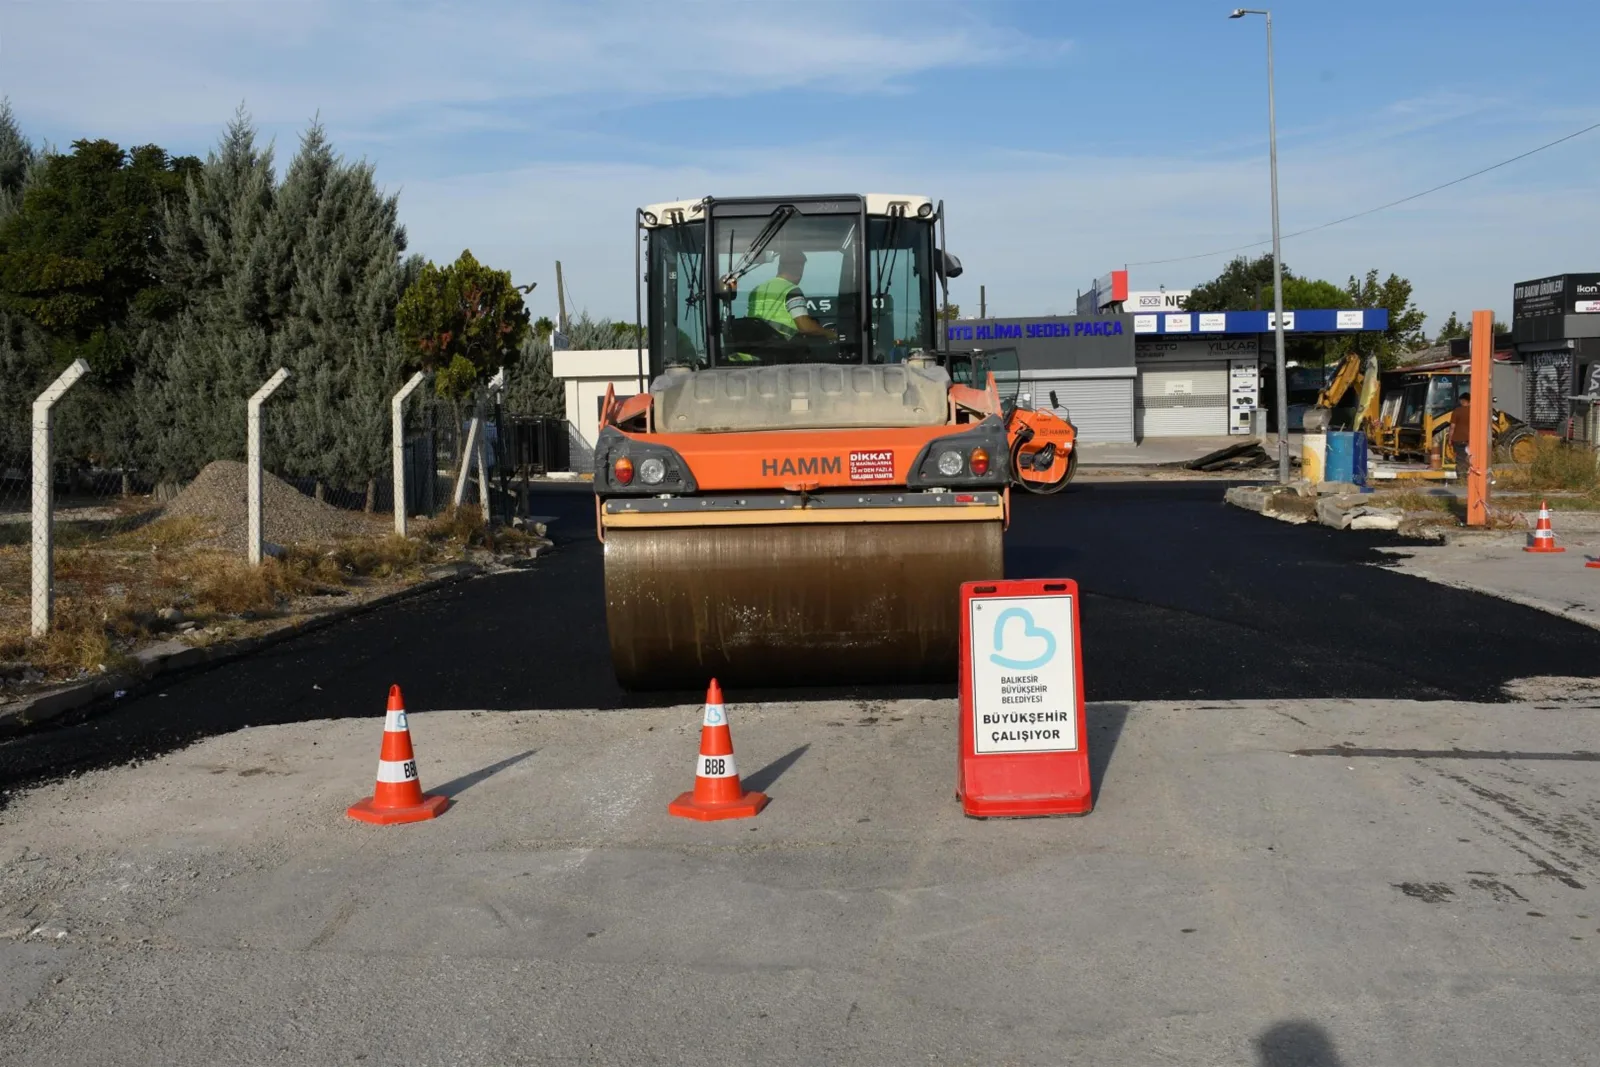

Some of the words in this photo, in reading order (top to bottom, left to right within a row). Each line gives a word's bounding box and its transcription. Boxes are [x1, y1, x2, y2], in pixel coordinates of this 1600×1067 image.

[1577, 285, 1597, 293] ikon
[976, 322, 1022, 340] KLİMA
[1026, 322, 1071, 338] YEDEK
[1074, 320, 1123, 337] PARÇA
[850, 452, 892, 461] DİKKAT
[762, 456, 842, 476] HAMM
[1001, 675, 1038, 684] BALIKESİR
[1001, 685, 1047, 694] BÜYÜKŞEHİR
[1002, 695, 1042, 704] BELEDİYESİ
[983, 710, 1067, 724] BÜYÜKŞEHİR
[991, 729, 1060, 743] ÇALIŞIYOR
[403, 760, 418, 779] BB
[704, 758, 726, 775] BBB
